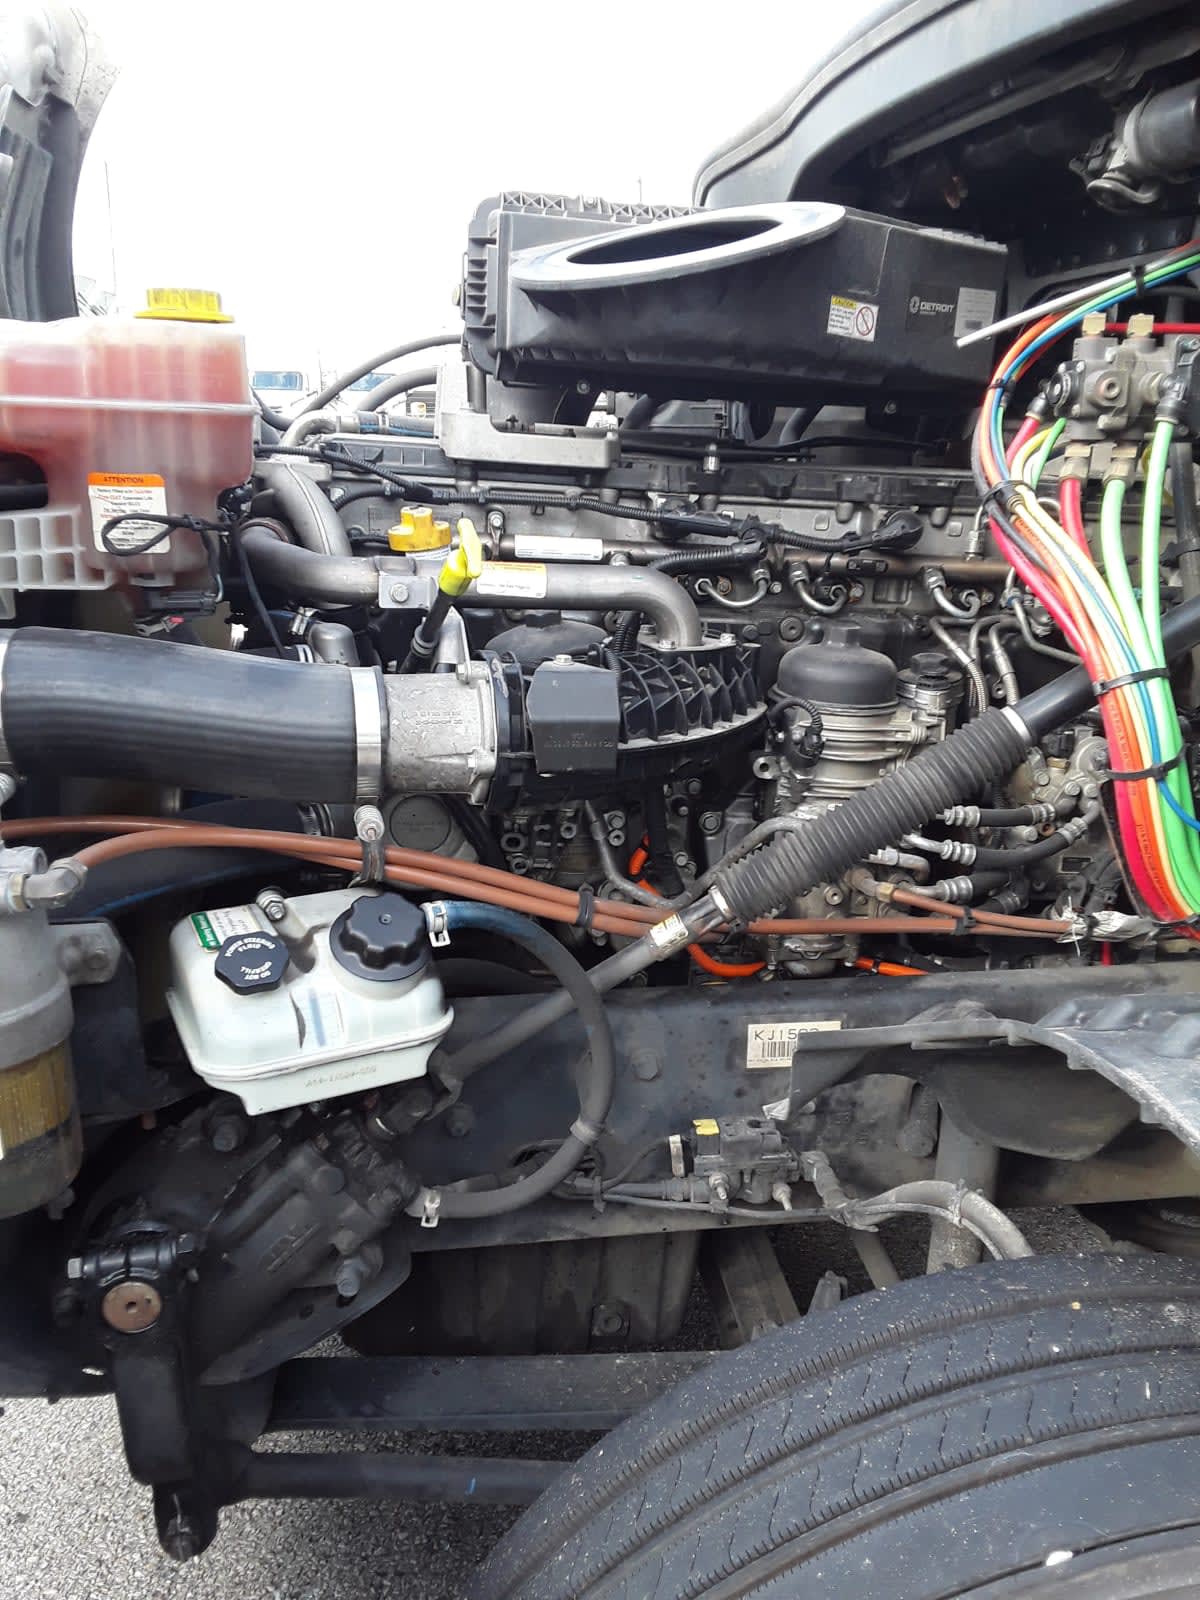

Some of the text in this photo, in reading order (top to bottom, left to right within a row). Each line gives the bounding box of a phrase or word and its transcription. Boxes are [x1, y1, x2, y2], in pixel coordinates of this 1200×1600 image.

[920, 301, 954, 313] DETROIT
[224, 937, 276, 957] POWER STEERING
[237, 943, 262, 952] FLUID
[240, 961, 272, 974] OVERFILL
[260, 970, 271, 978] DO
